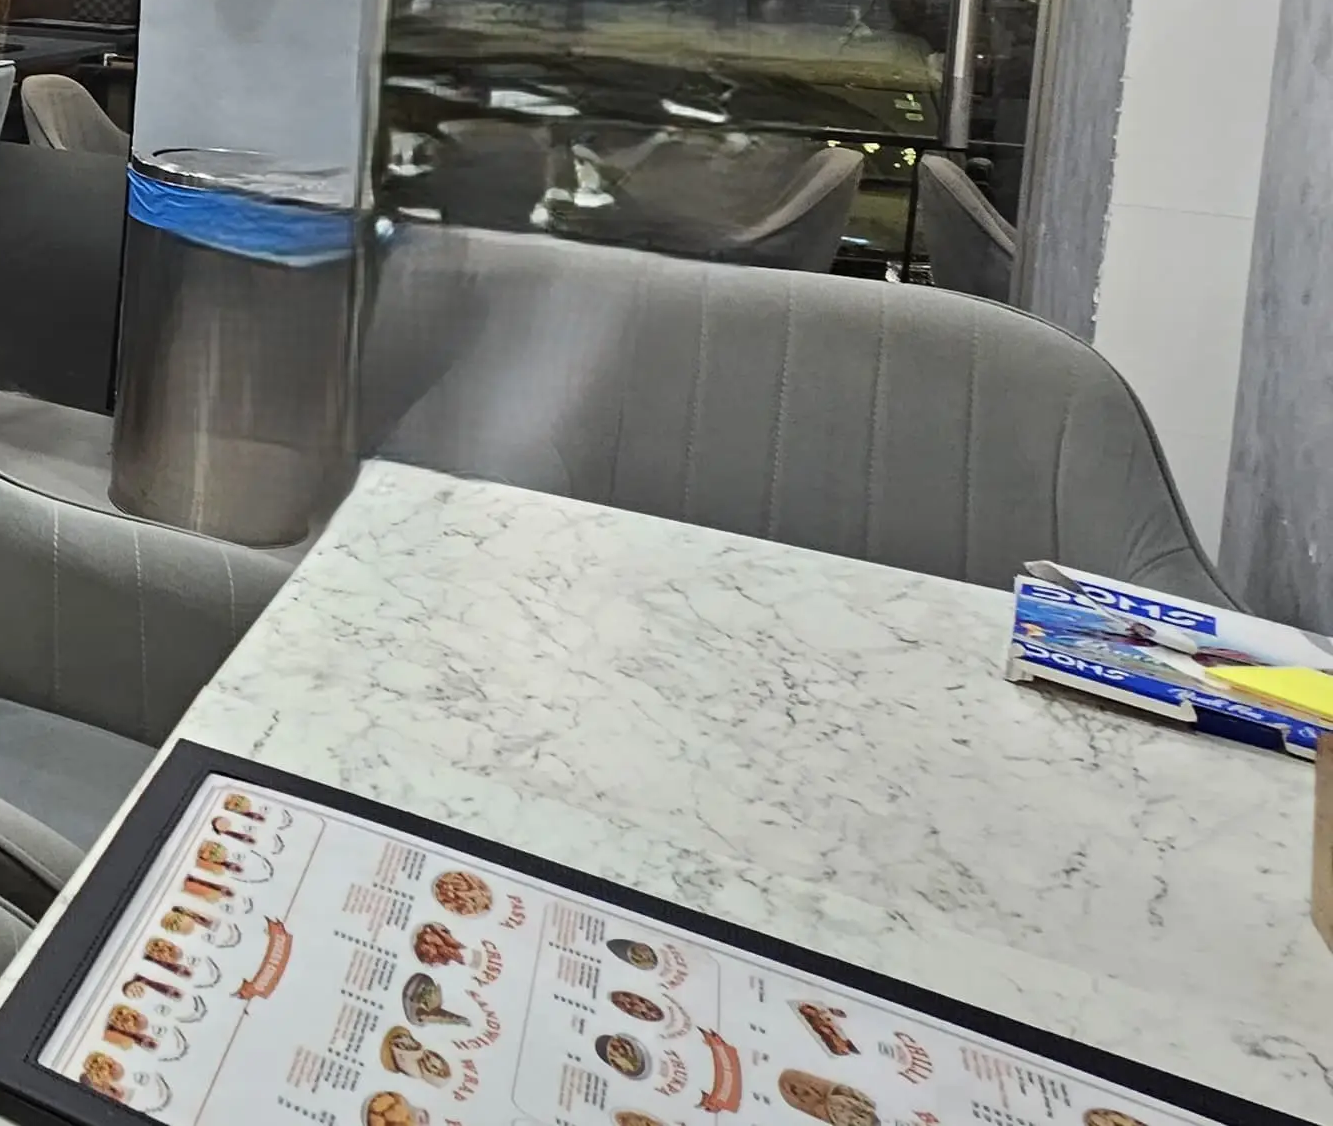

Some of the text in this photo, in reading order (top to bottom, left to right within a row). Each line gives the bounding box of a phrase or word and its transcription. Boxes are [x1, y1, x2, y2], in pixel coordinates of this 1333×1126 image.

[1023, 644, 1130, 681] DOMS
[499, 893, 527, 931] PASTA
[470, 938, 504, 989] CRISPY
[452, 1058, 480, 1103] WRAP
